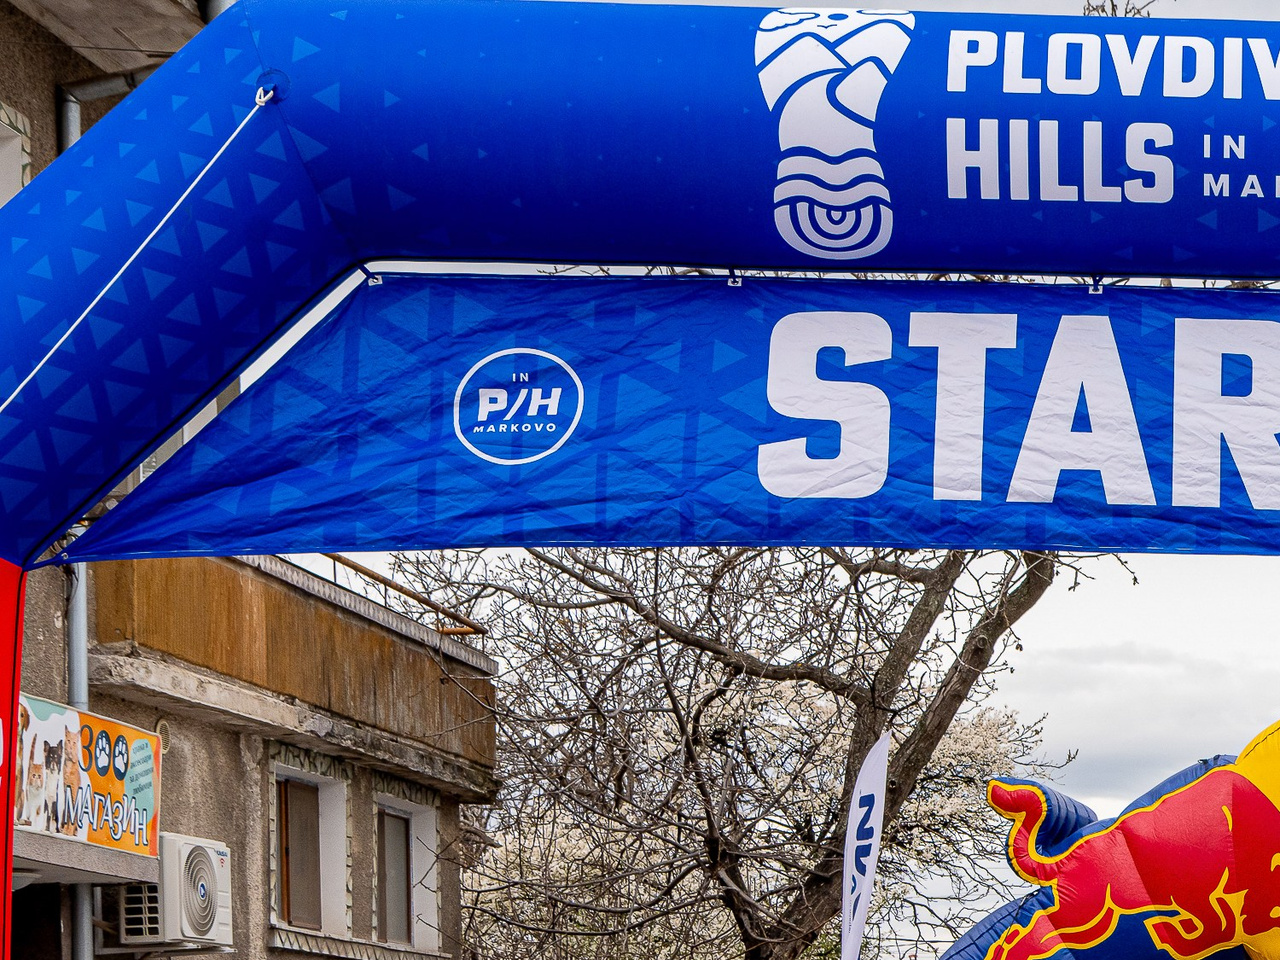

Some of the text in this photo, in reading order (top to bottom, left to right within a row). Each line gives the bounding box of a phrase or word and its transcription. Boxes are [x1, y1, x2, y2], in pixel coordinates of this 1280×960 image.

[946, 118, 1175, 204] HILLS
[1203, 134, 1247, 160] IN
[512, 372, 529, 383] IN
[477, 387, 562, 422] P/H
[473, 422, 557, 434] MARKOVO
[65, 784, 149, 846] МАГАЗИН
